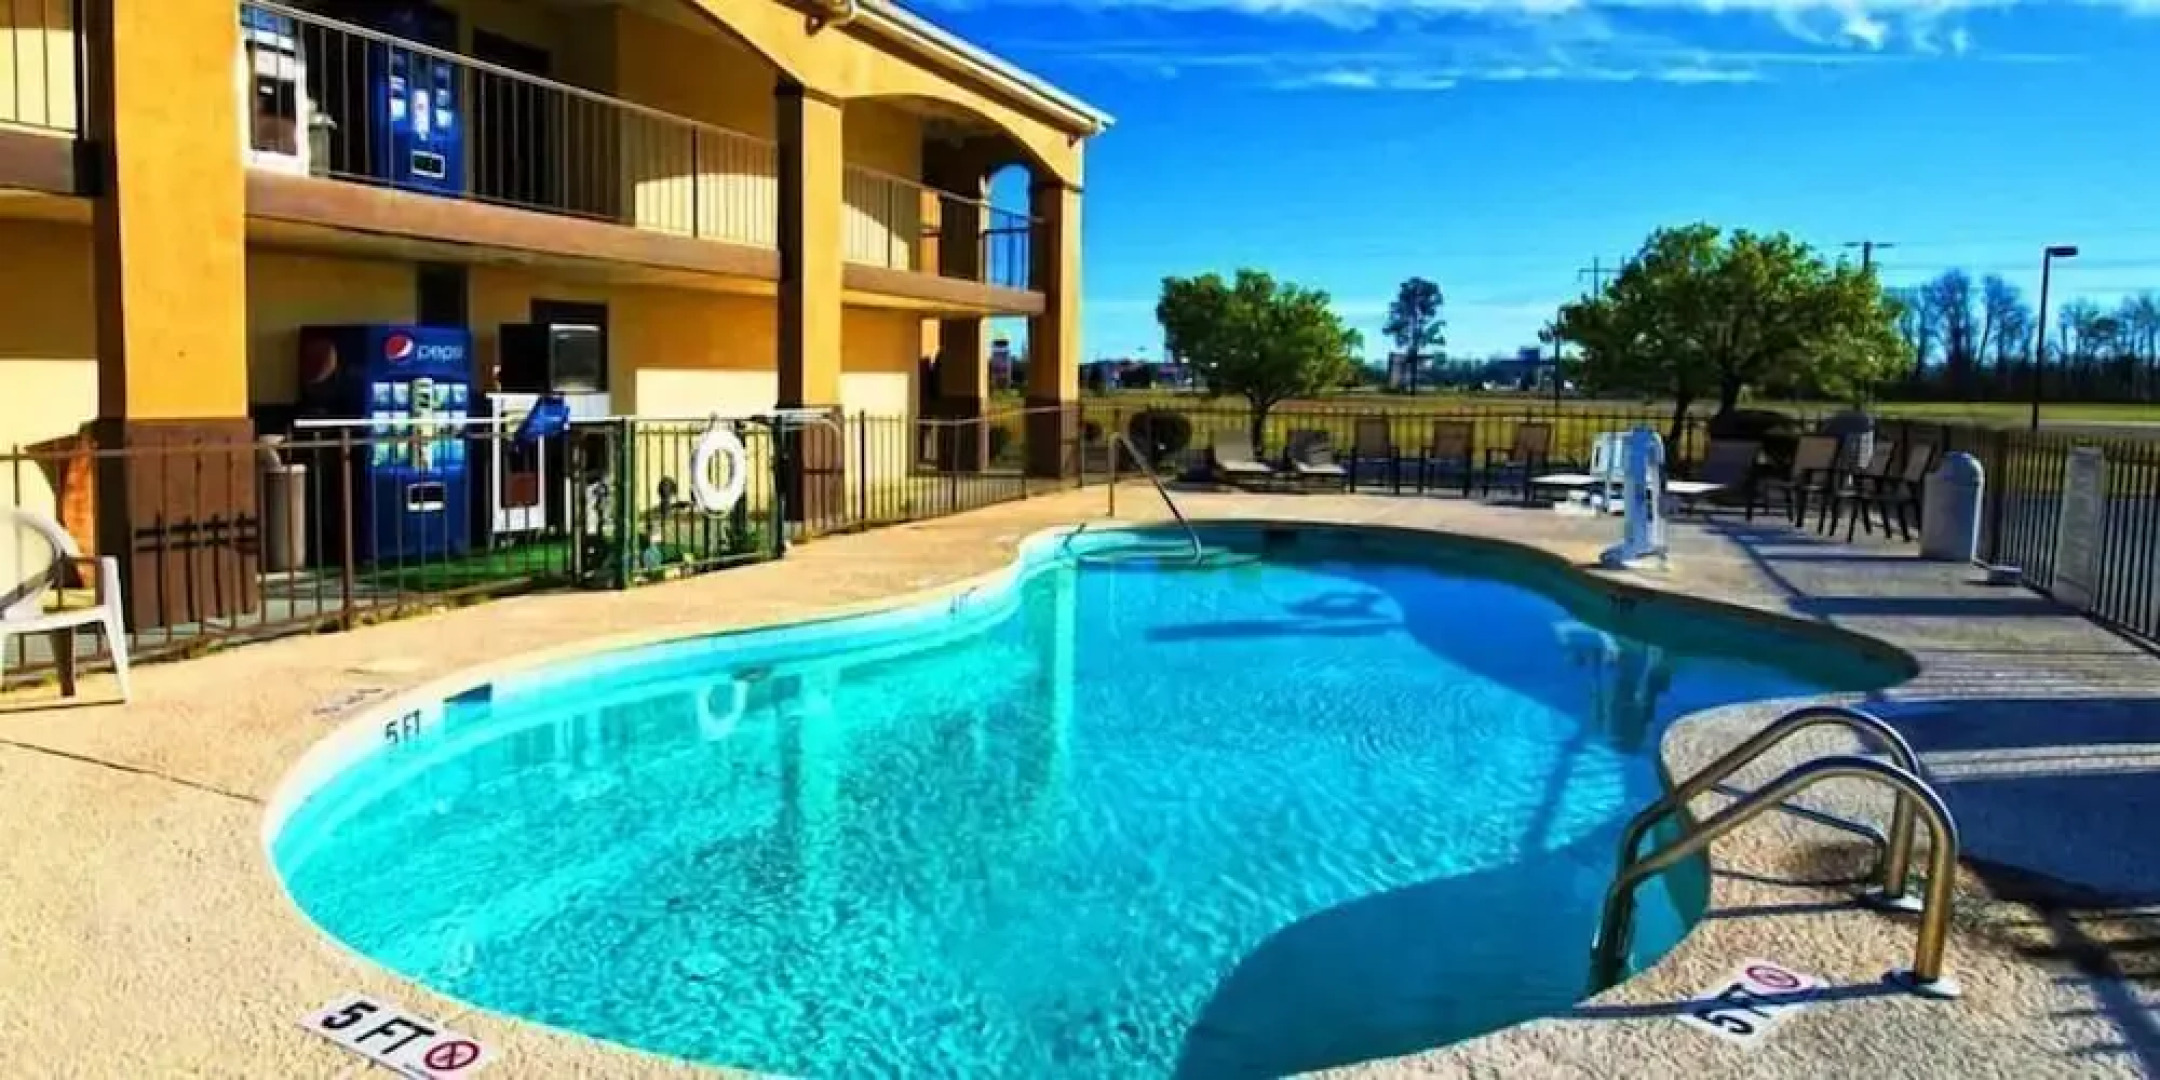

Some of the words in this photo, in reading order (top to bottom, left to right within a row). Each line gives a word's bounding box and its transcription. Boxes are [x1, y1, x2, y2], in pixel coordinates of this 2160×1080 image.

[385, 721, 399, 744] 5
[403, 709, 421, 745] FT
[321, 1000, 379, 1030] 5
[354, 1016, 437, 1055] FT
[1692, 1008, 1755, 1034] 5
